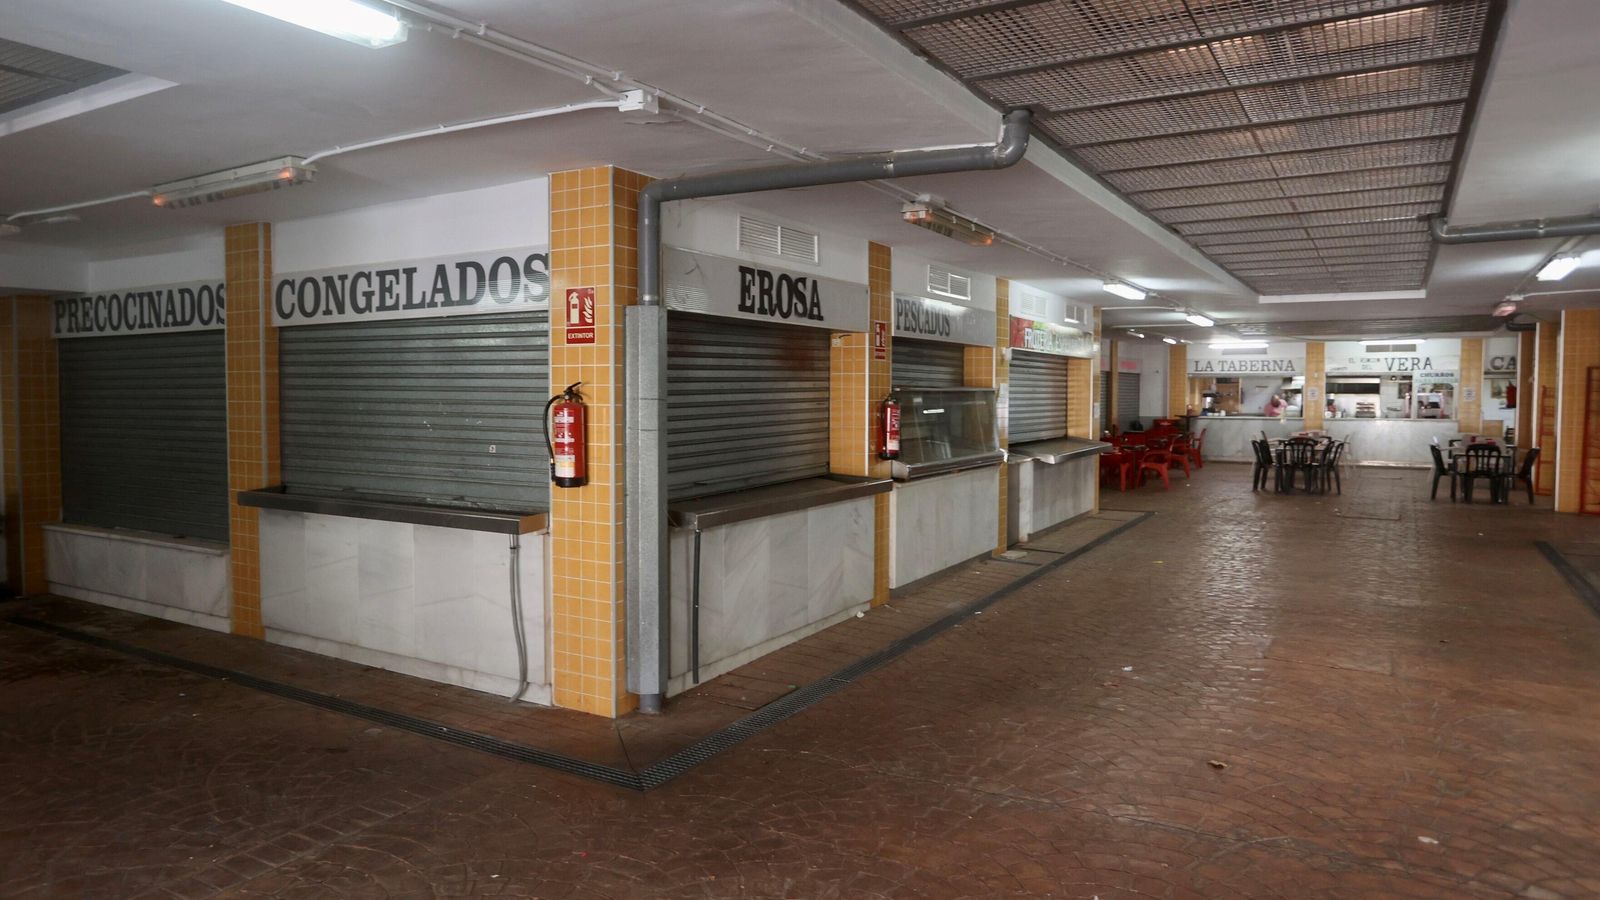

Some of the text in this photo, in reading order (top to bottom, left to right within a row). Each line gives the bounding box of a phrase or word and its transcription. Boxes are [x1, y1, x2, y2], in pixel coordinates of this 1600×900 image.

[277, 253, 549, 321] CONGELADOS
[738, 265, 824, 322] EROSA
[55, 283, 226, 334] PRECOCINADOS
[896, 298, 951, 337] PESCADOS
[567, 332, 595, 340] EXTINTOR
[1194, 359, 1296, 372] LA TABERNA
[1385, 357, 1434, 371] VERA
[1491, 356, 1517, 370] CA
